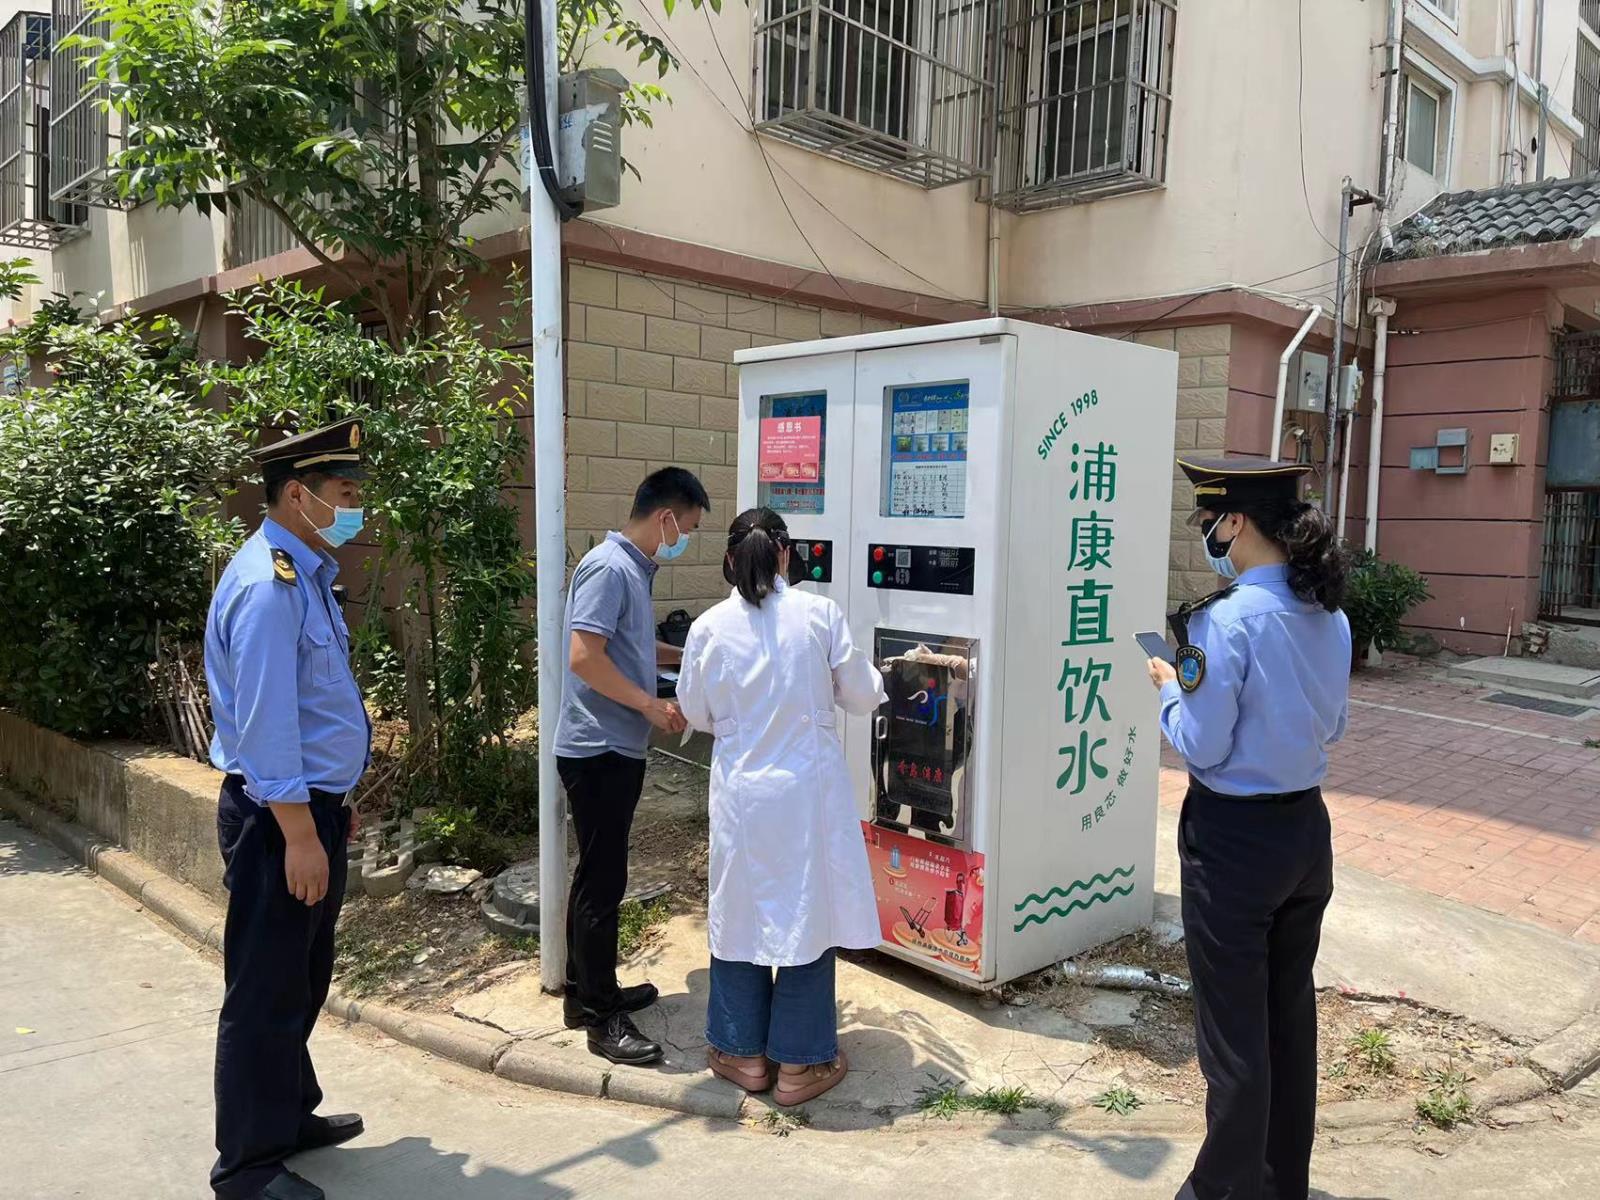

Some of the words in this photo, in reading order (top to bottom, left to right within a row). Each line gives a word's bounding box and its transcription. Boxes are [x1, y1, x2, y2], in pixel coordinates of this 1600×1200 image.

[1037, 412, 1069, 460] SINCE
[1070, 389, 1099, 417] 1998
[1056, 441, 1118, 796] 浦康直饮水
